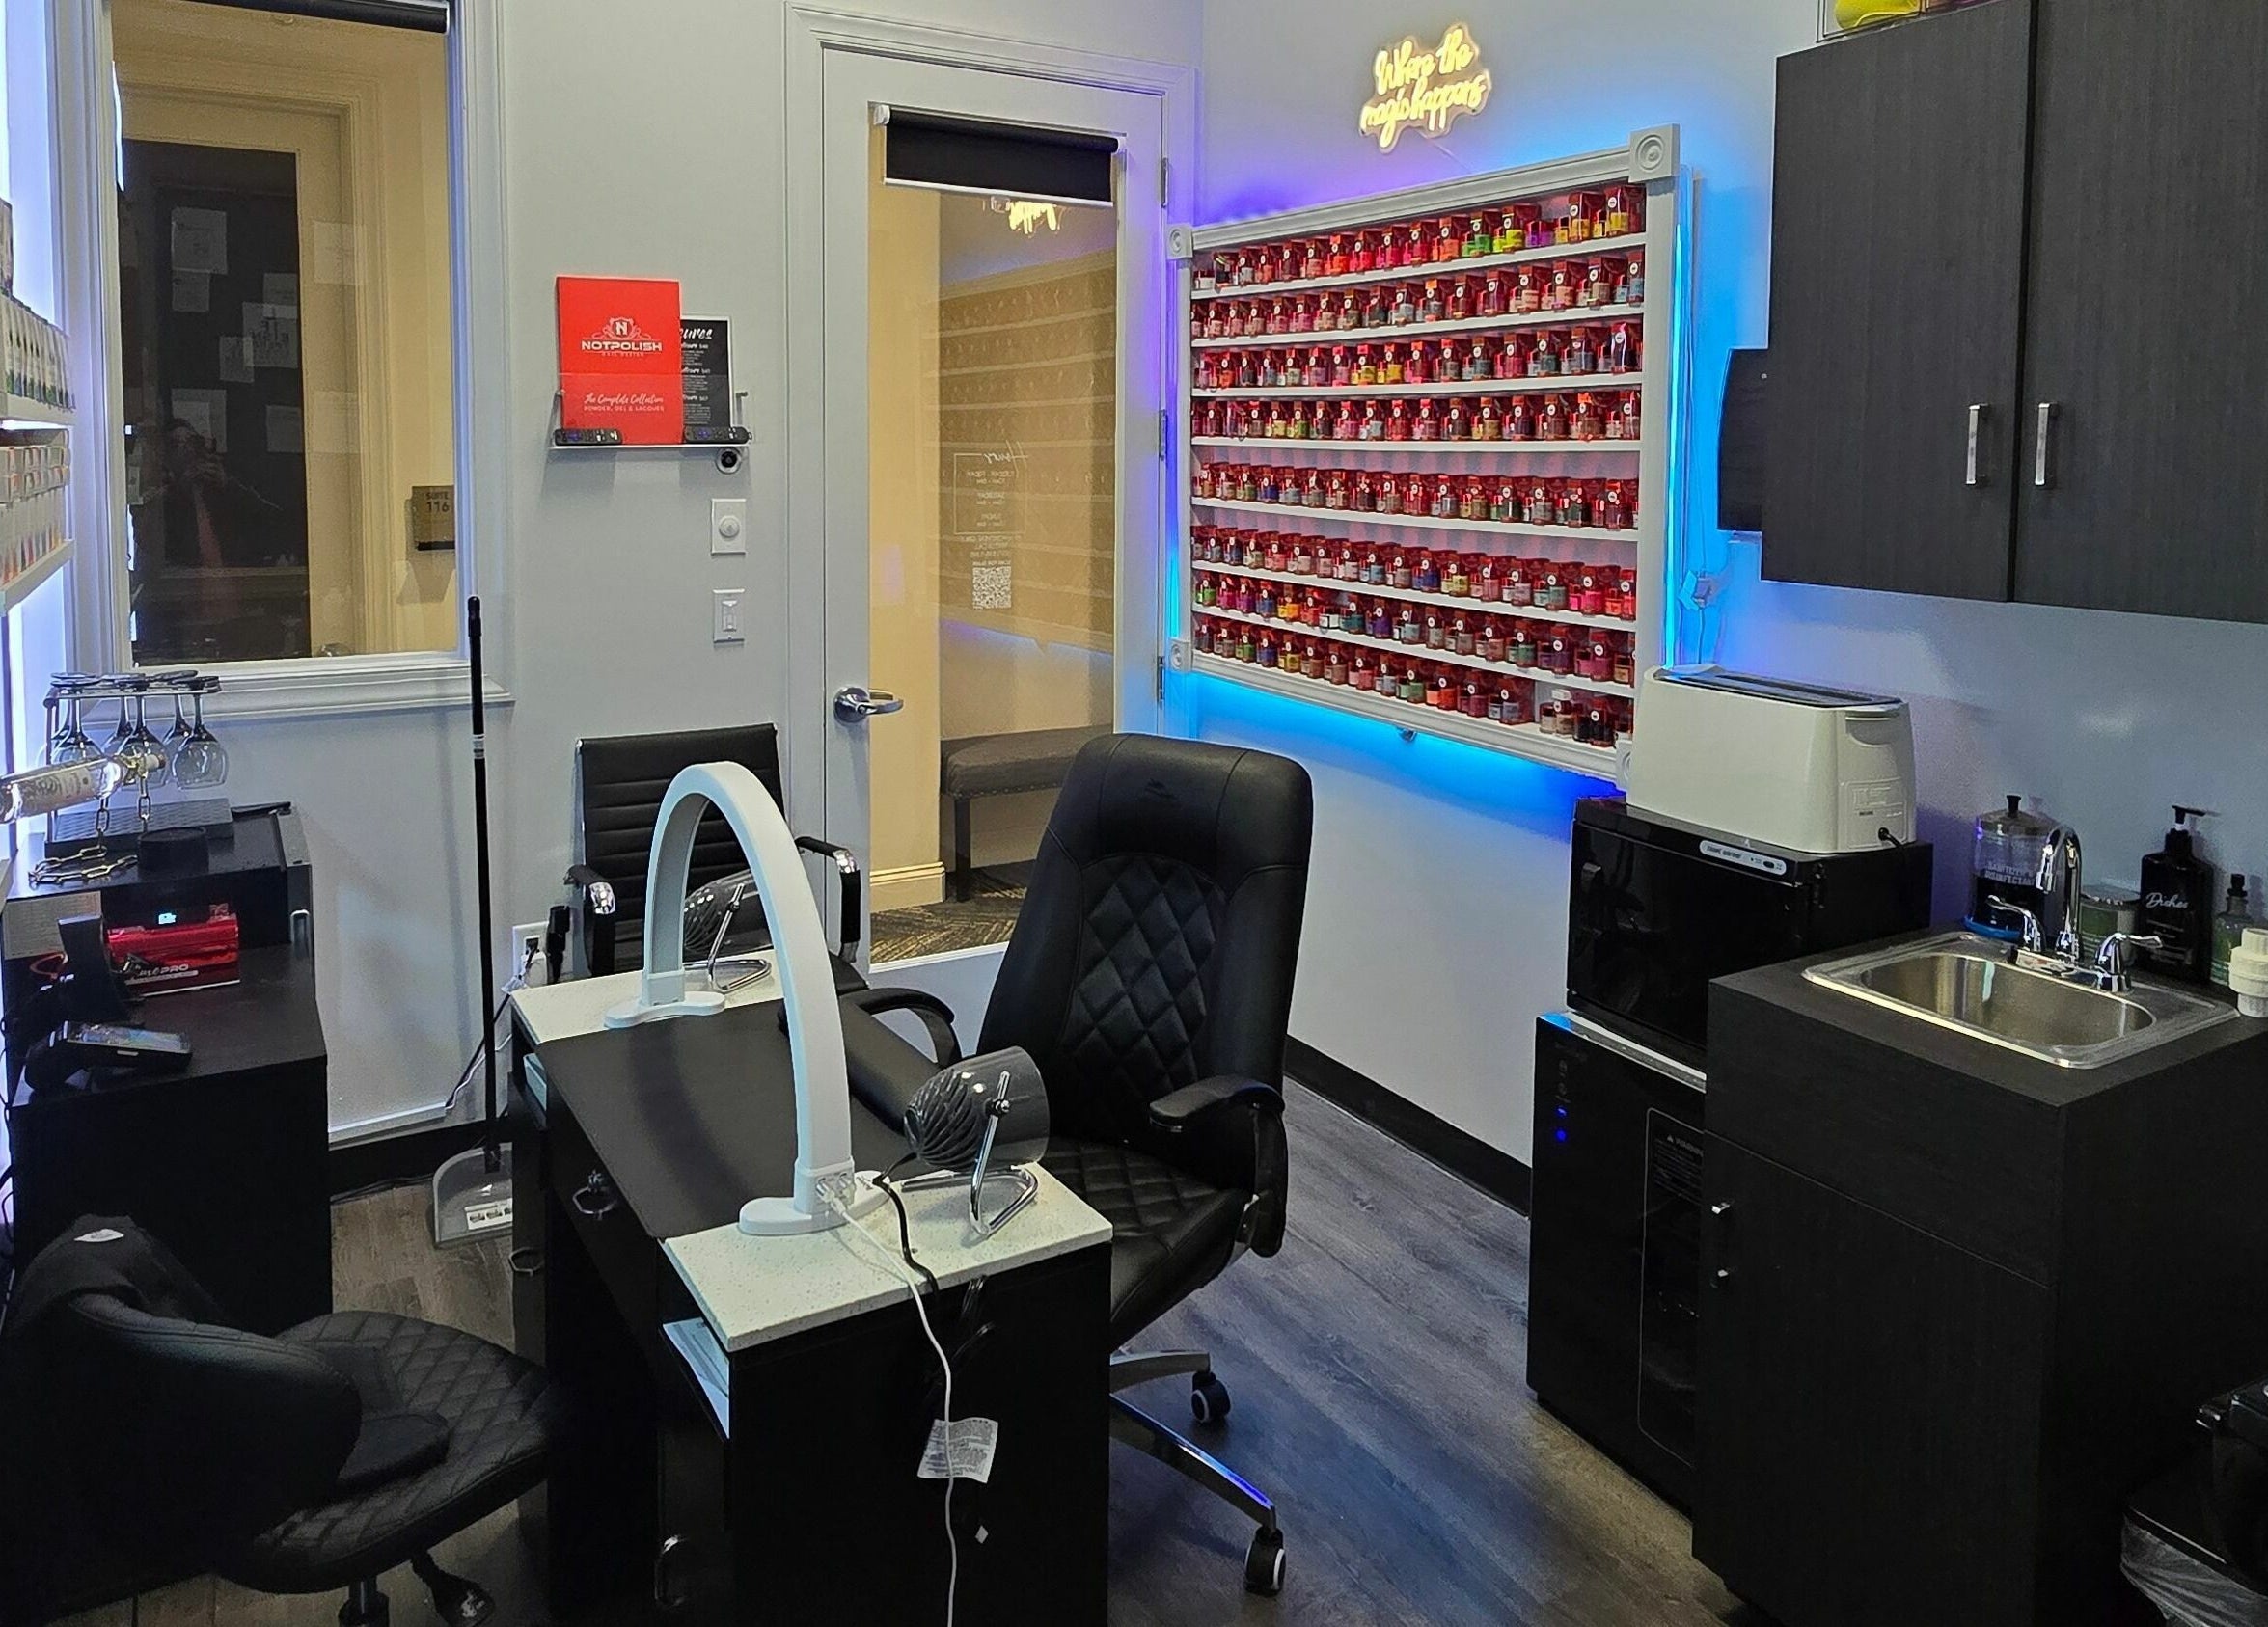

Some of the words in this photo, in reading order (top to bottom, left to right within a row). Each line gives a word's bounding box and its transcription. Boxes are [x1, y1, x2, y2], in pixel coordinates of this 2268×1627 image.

[1435, 28, 1475, 74] the
[581, 340, 663, 352] NOTPOLISH
[426, 502, 450, 512] 116
